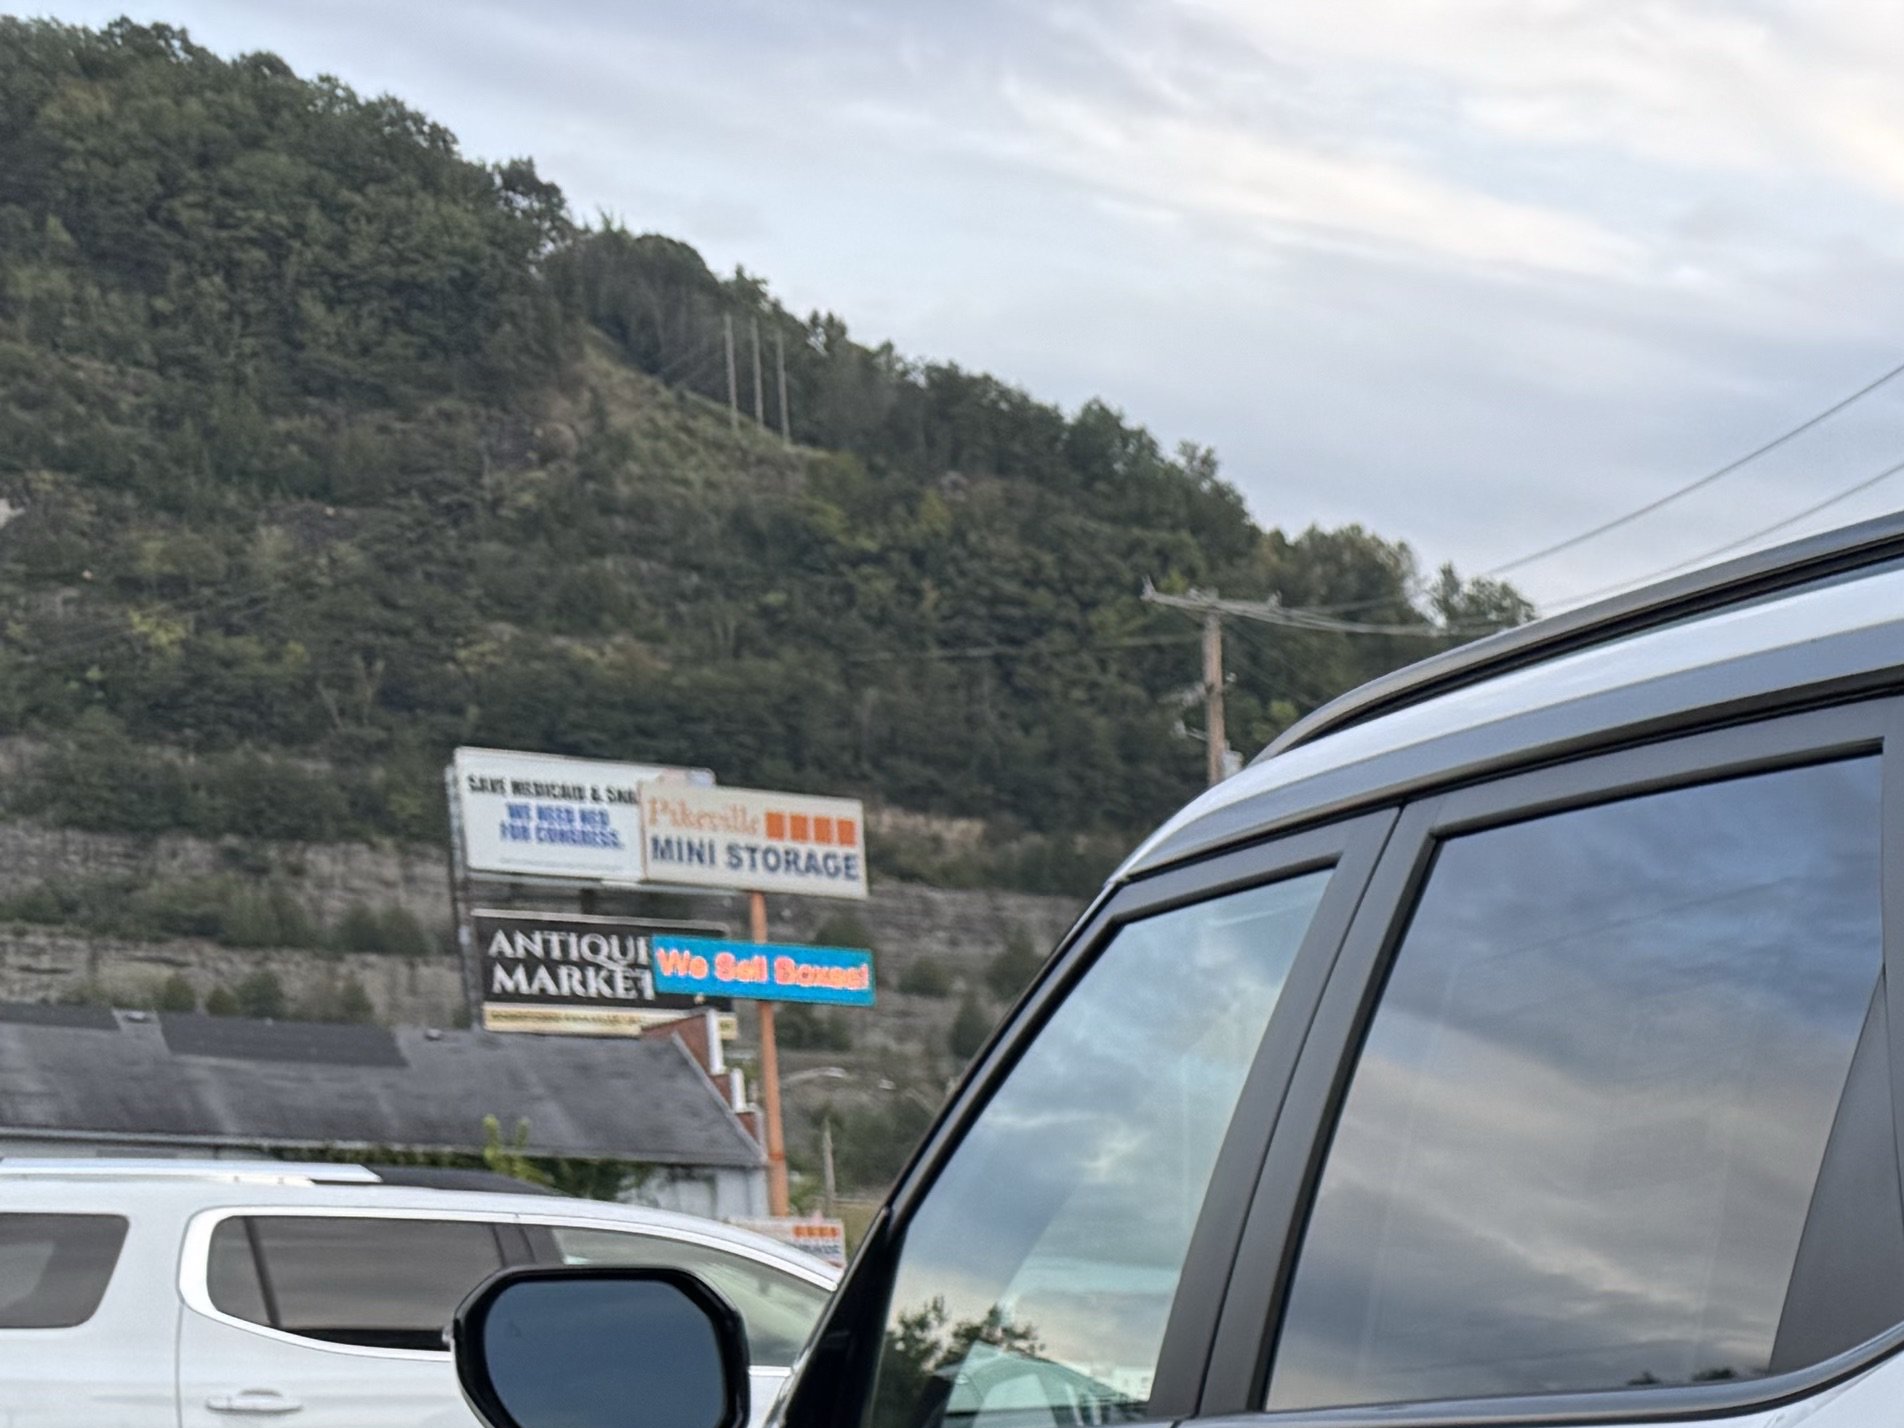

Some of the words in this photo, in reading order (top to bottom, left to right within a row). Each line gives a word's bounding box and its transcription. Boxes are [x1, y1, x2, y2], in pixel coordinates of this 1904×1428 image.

[468, 773, 506, 796] SAVE
[647, 797, 759, 836] Pikeville
[651, 836, 716, 866] MINI
[726, 843, 860, 881] STORAGE
[491, 963, 656, 1001] MARKET
[656, 948, 708, 980] We
[714, 952, 768, 983] Sell
